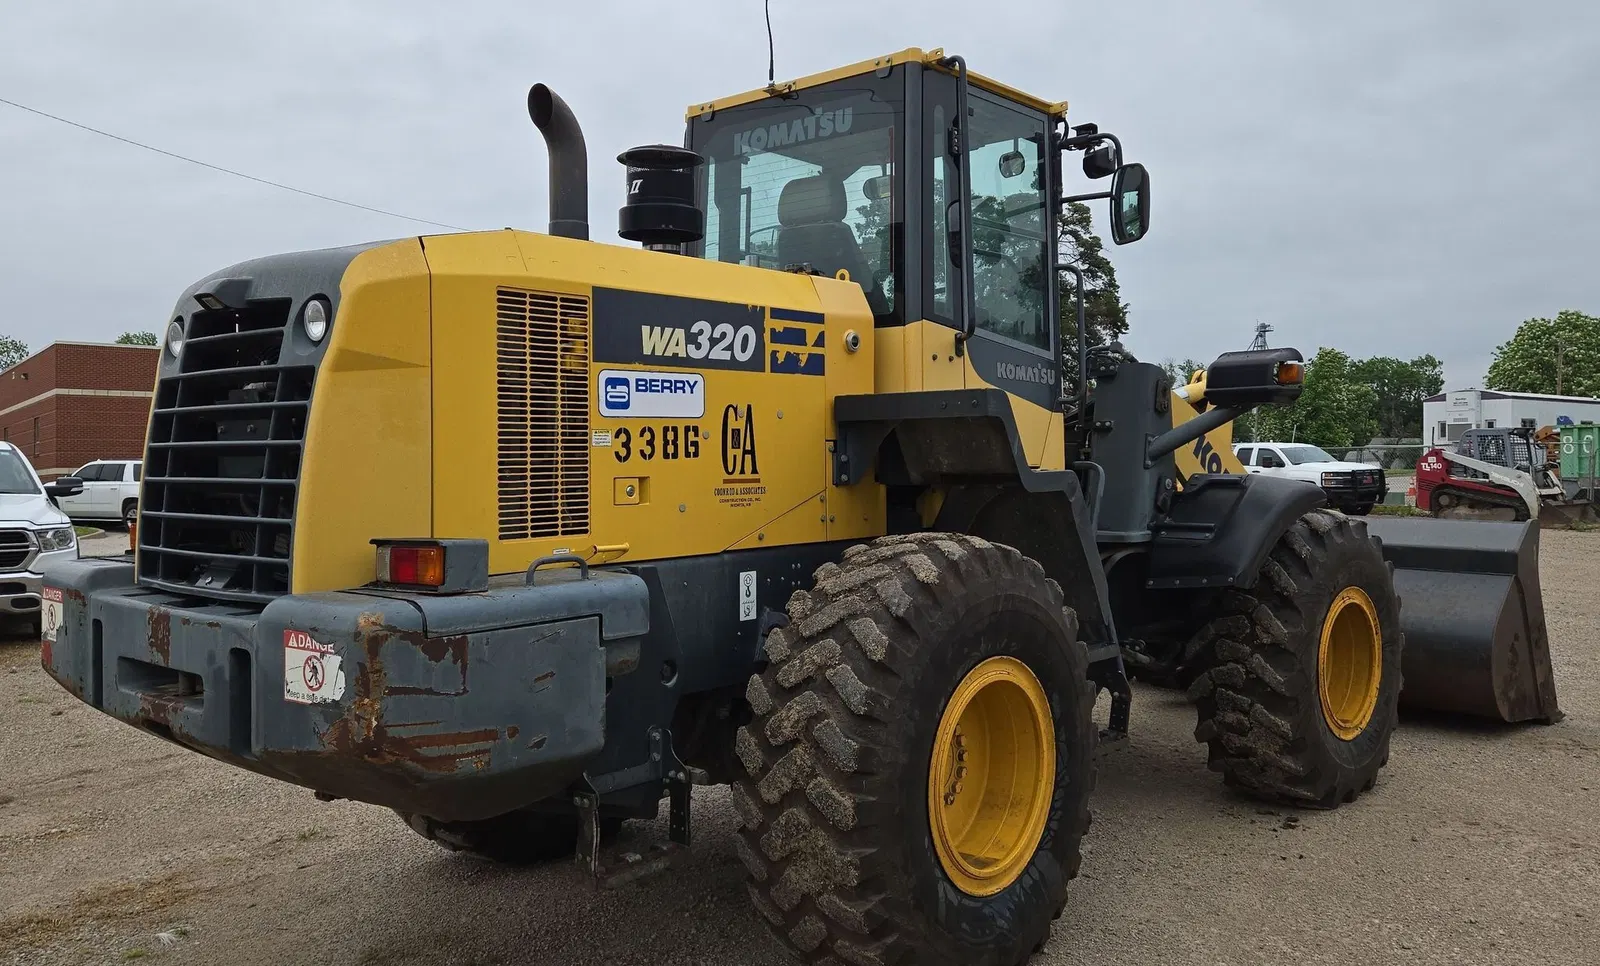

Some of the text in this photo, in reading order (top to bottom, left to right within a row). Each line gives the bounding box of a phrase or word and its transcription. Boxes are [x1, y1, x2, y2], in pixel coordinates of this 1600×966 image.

[733, 107, 853, 156] KOMATSU
[641, 320, 756, 362] WA320
[996, 362, 1056, 385] KOMATSU
[635, 378, 698, 394] BERRY
[1421, 463, 1442, 471] TL140
[740, 486, 767, 495] ASSOCIATES
[298, 634, 335, 653] DANGE
